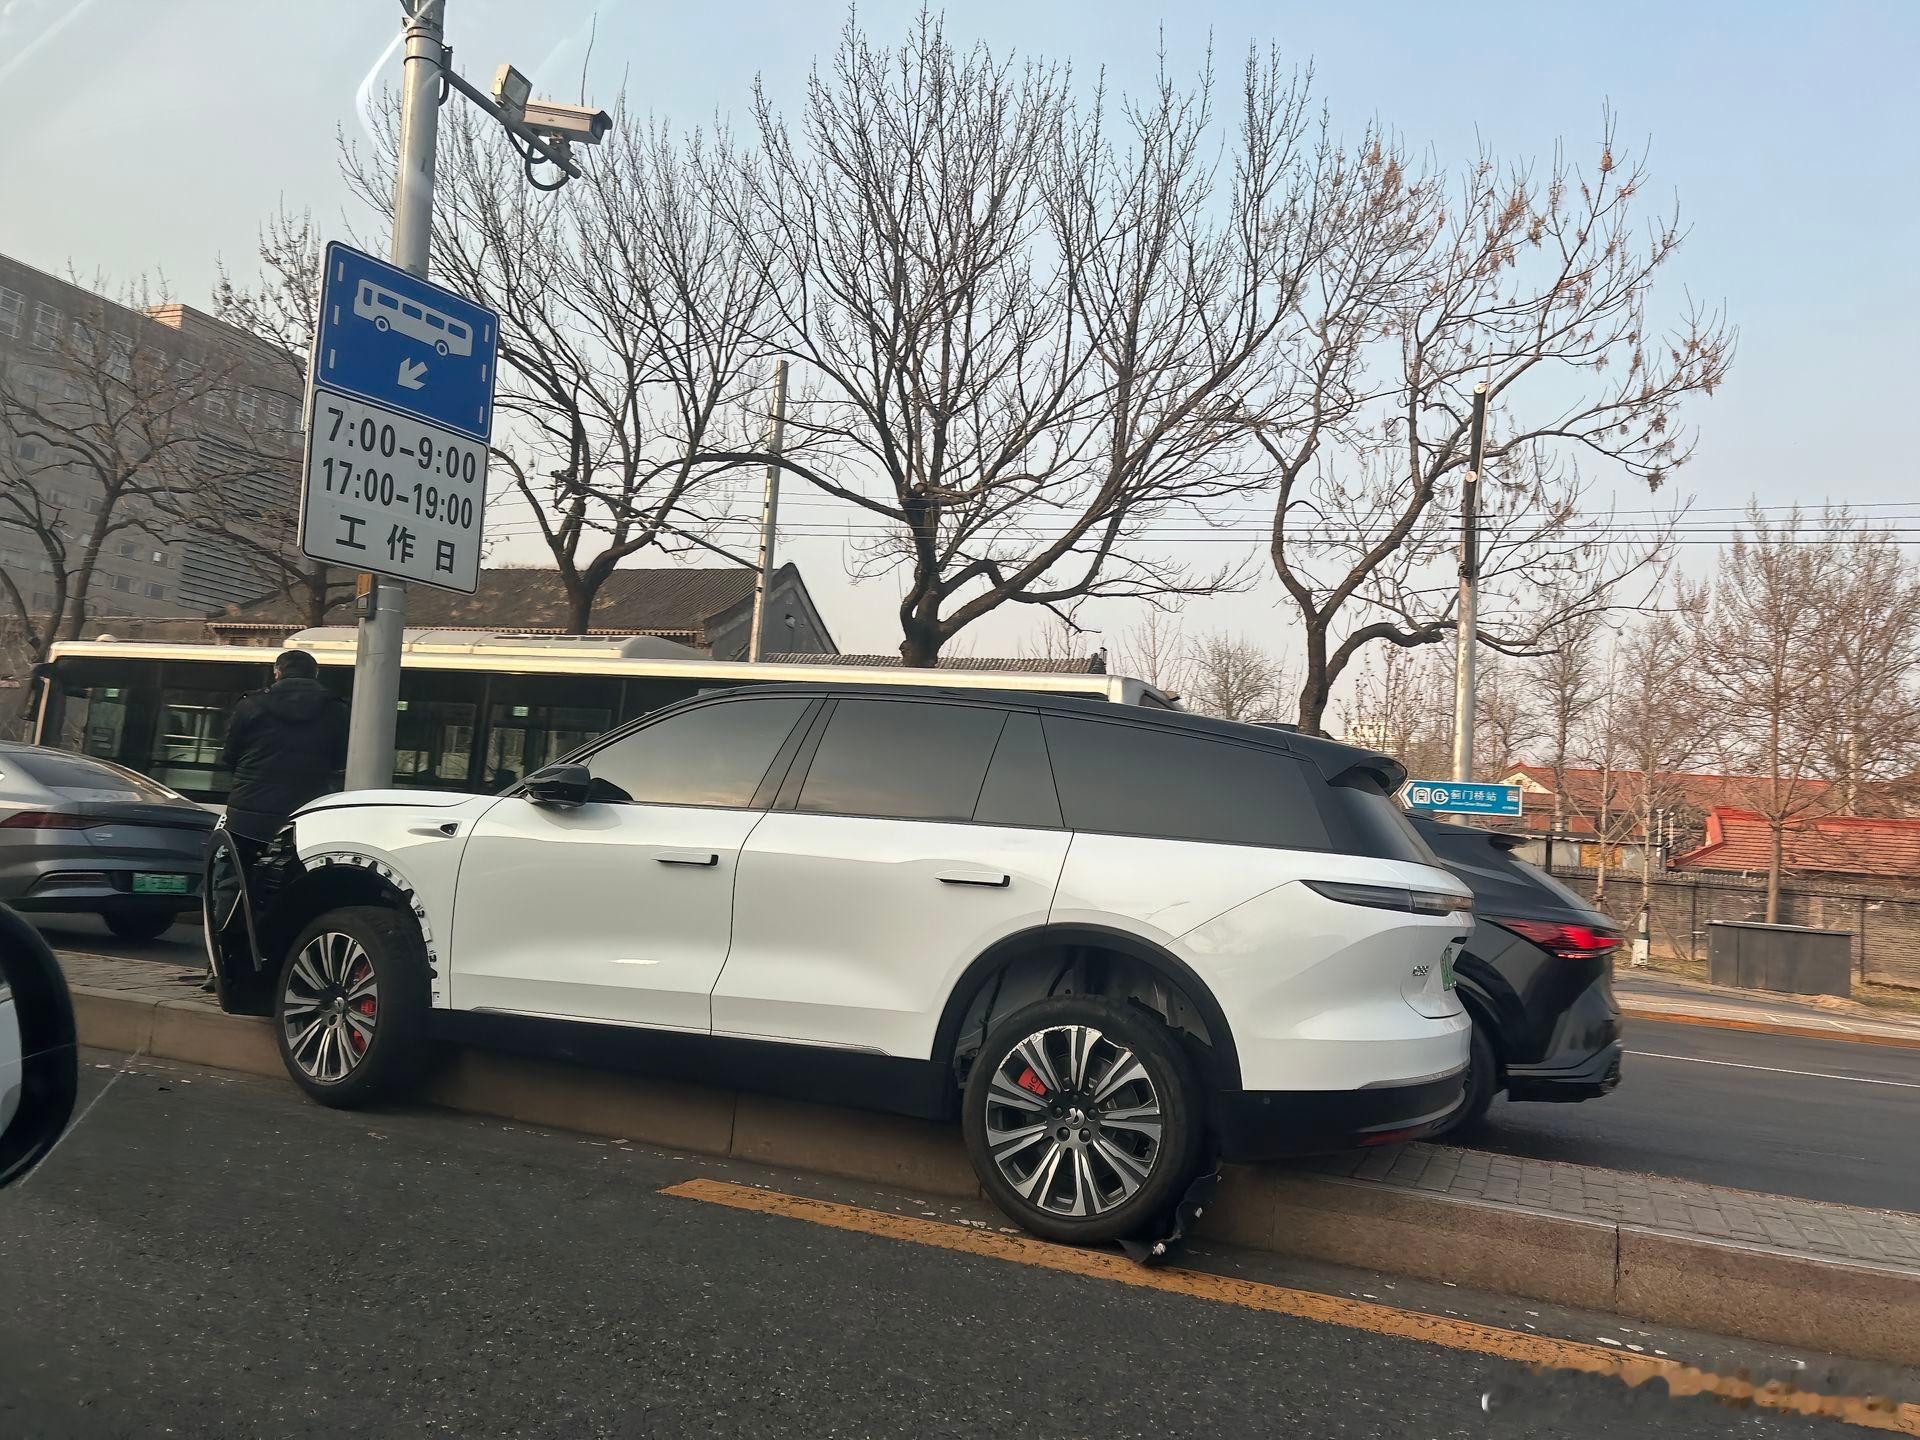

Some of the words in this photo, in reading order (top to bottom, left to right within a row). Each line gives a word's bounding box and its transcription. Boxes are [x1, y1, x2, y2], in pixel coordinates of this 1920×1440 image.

[328, 407, 476, 483] 7:00-9:00
[322, 457, 473, 529] 17:00-19:00
[335, 514, 455, 574] 工作日
